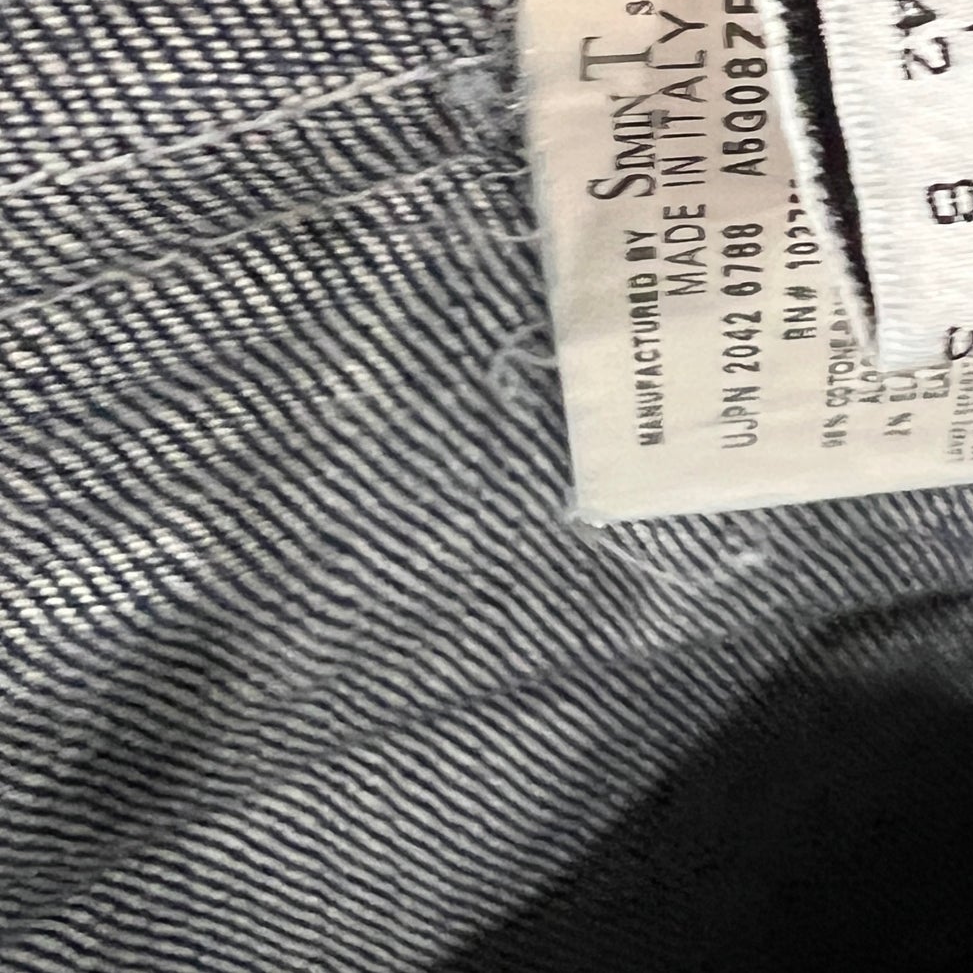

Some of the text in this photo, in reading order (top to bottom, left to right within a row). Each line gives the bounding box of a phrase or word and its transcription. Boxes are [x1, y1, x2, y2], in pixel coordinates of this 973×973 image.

[658, 11, 708, 296] MADE IN ITALY
[720, 311, 762, 373] 2042
[720, 387, 762, 449] UJPN
